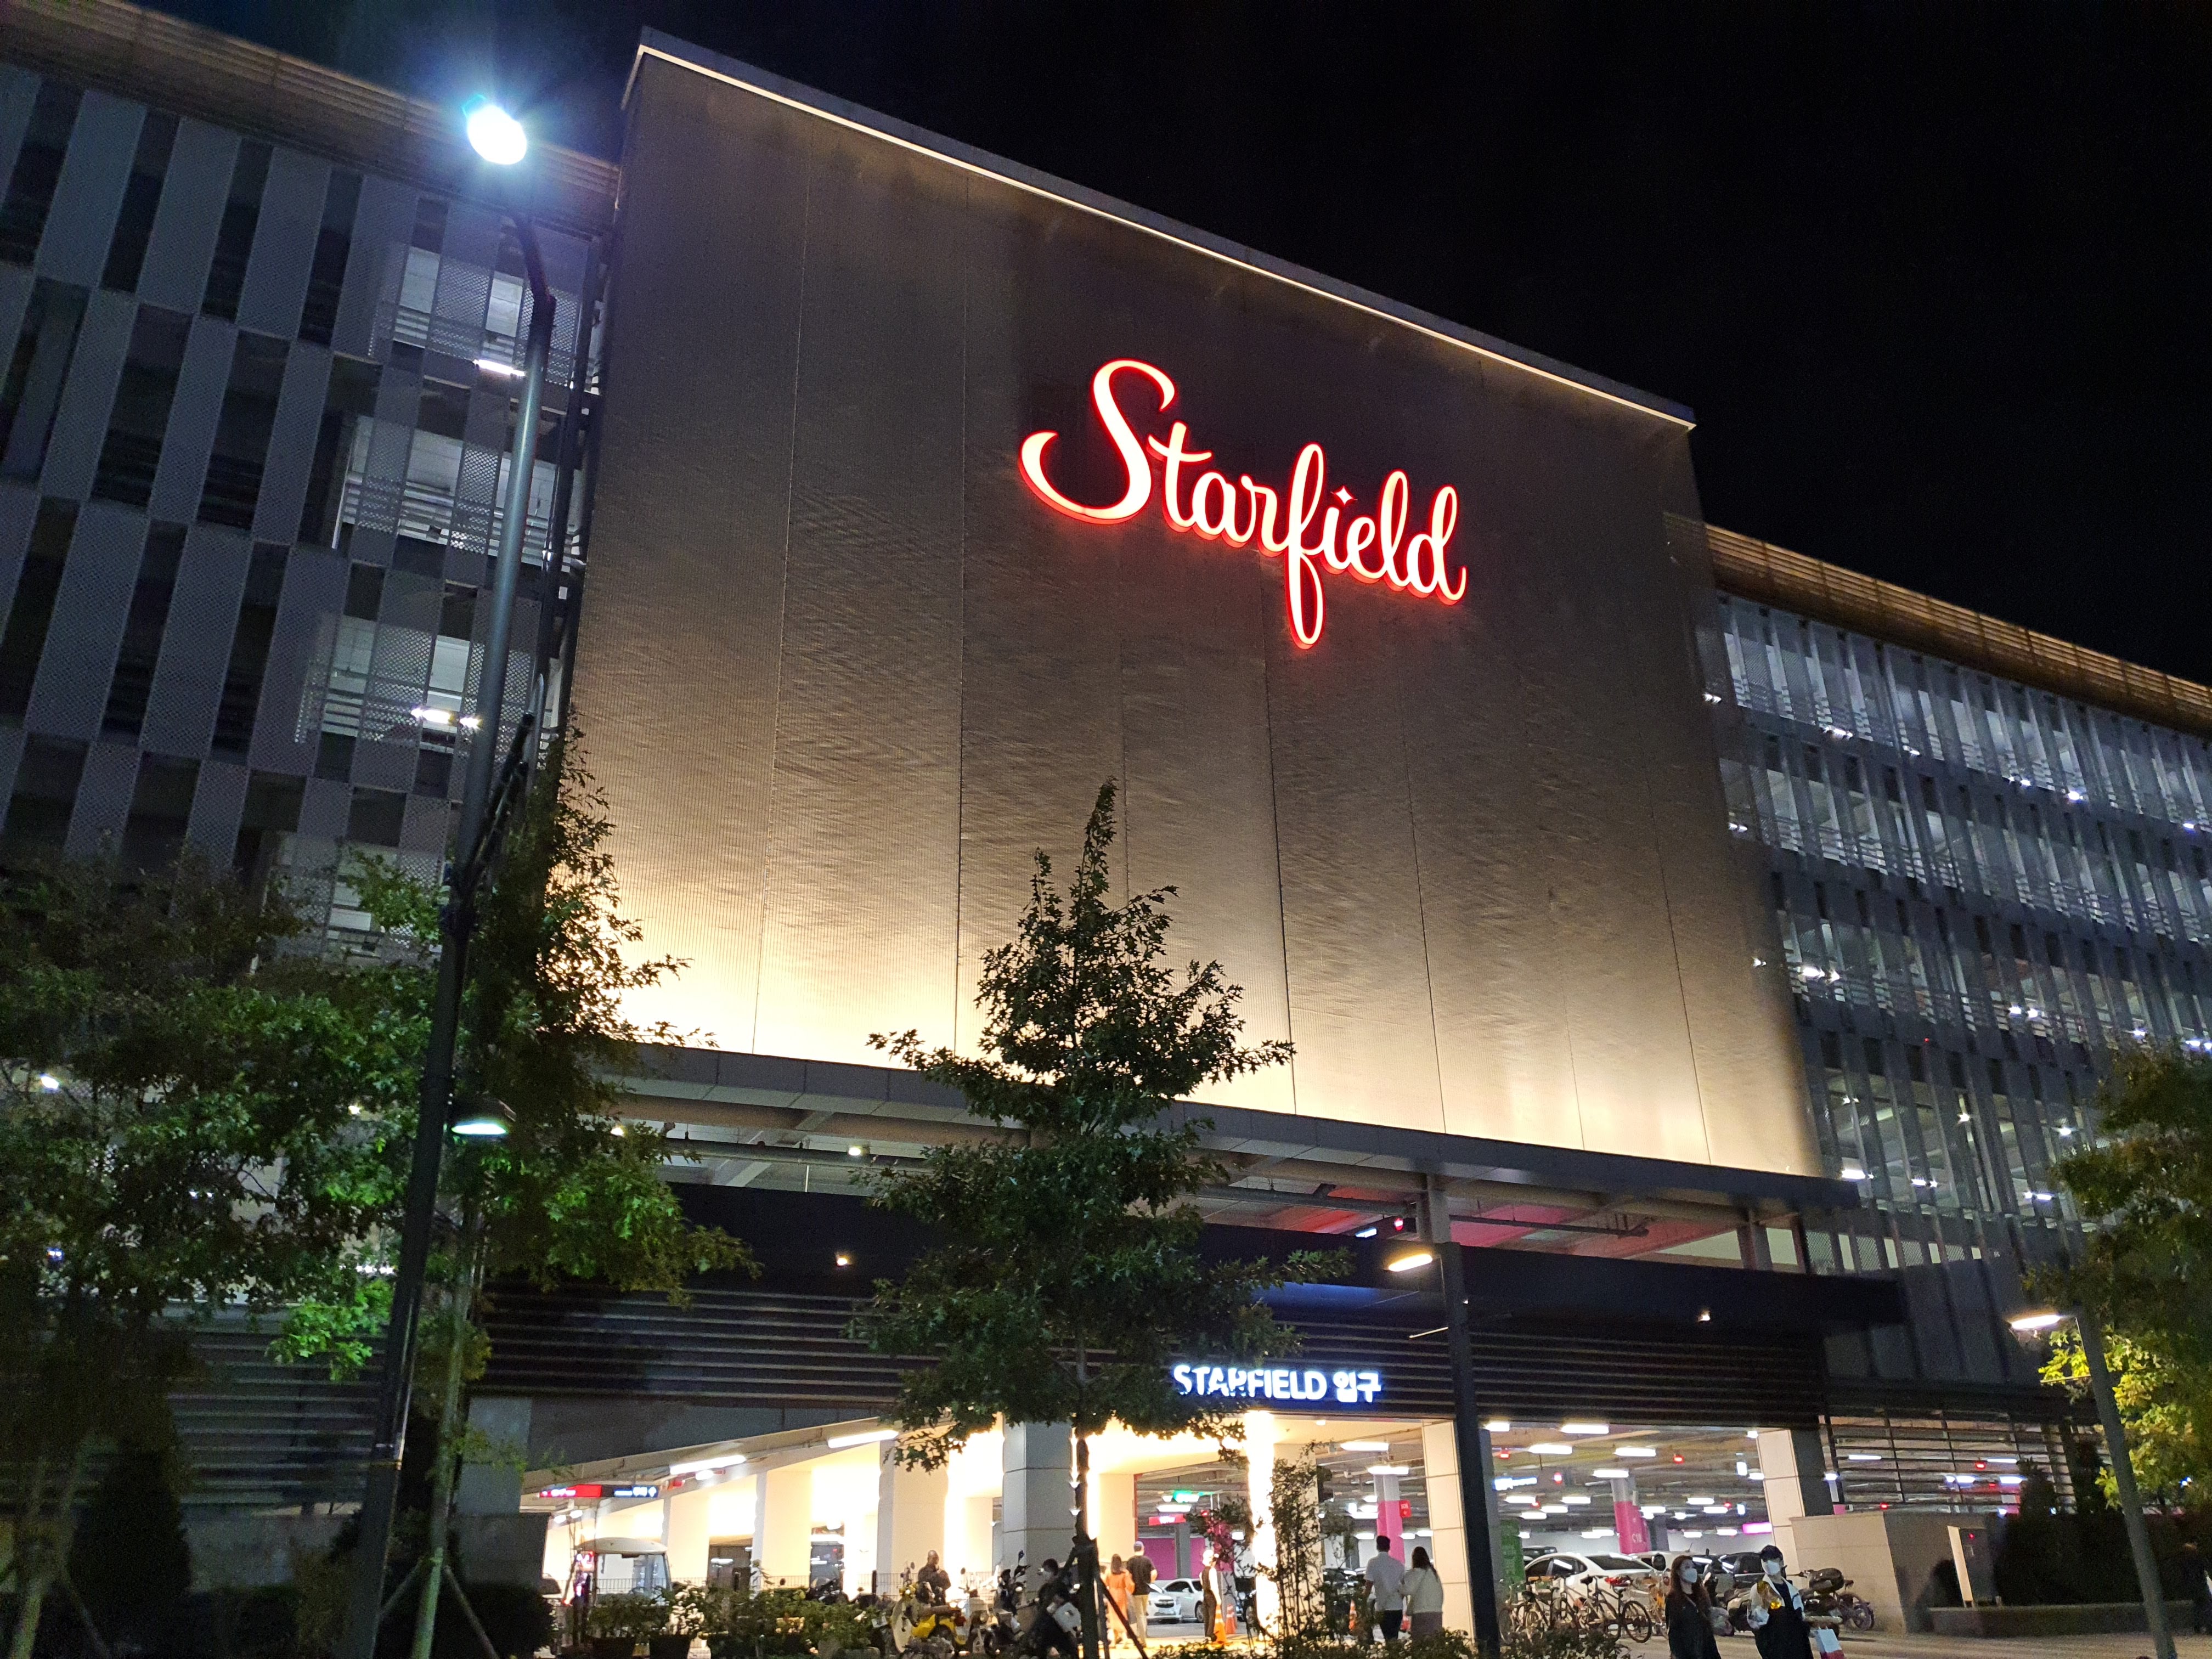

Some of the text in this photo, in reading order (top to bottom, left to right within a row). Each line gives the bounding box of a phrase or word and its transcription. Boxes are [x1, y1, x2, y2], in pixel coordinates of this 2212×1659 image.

[1020, 359, 1466, 648] Starfield
[1173, 1364, 1381, 1403] STARFIELD 입구
